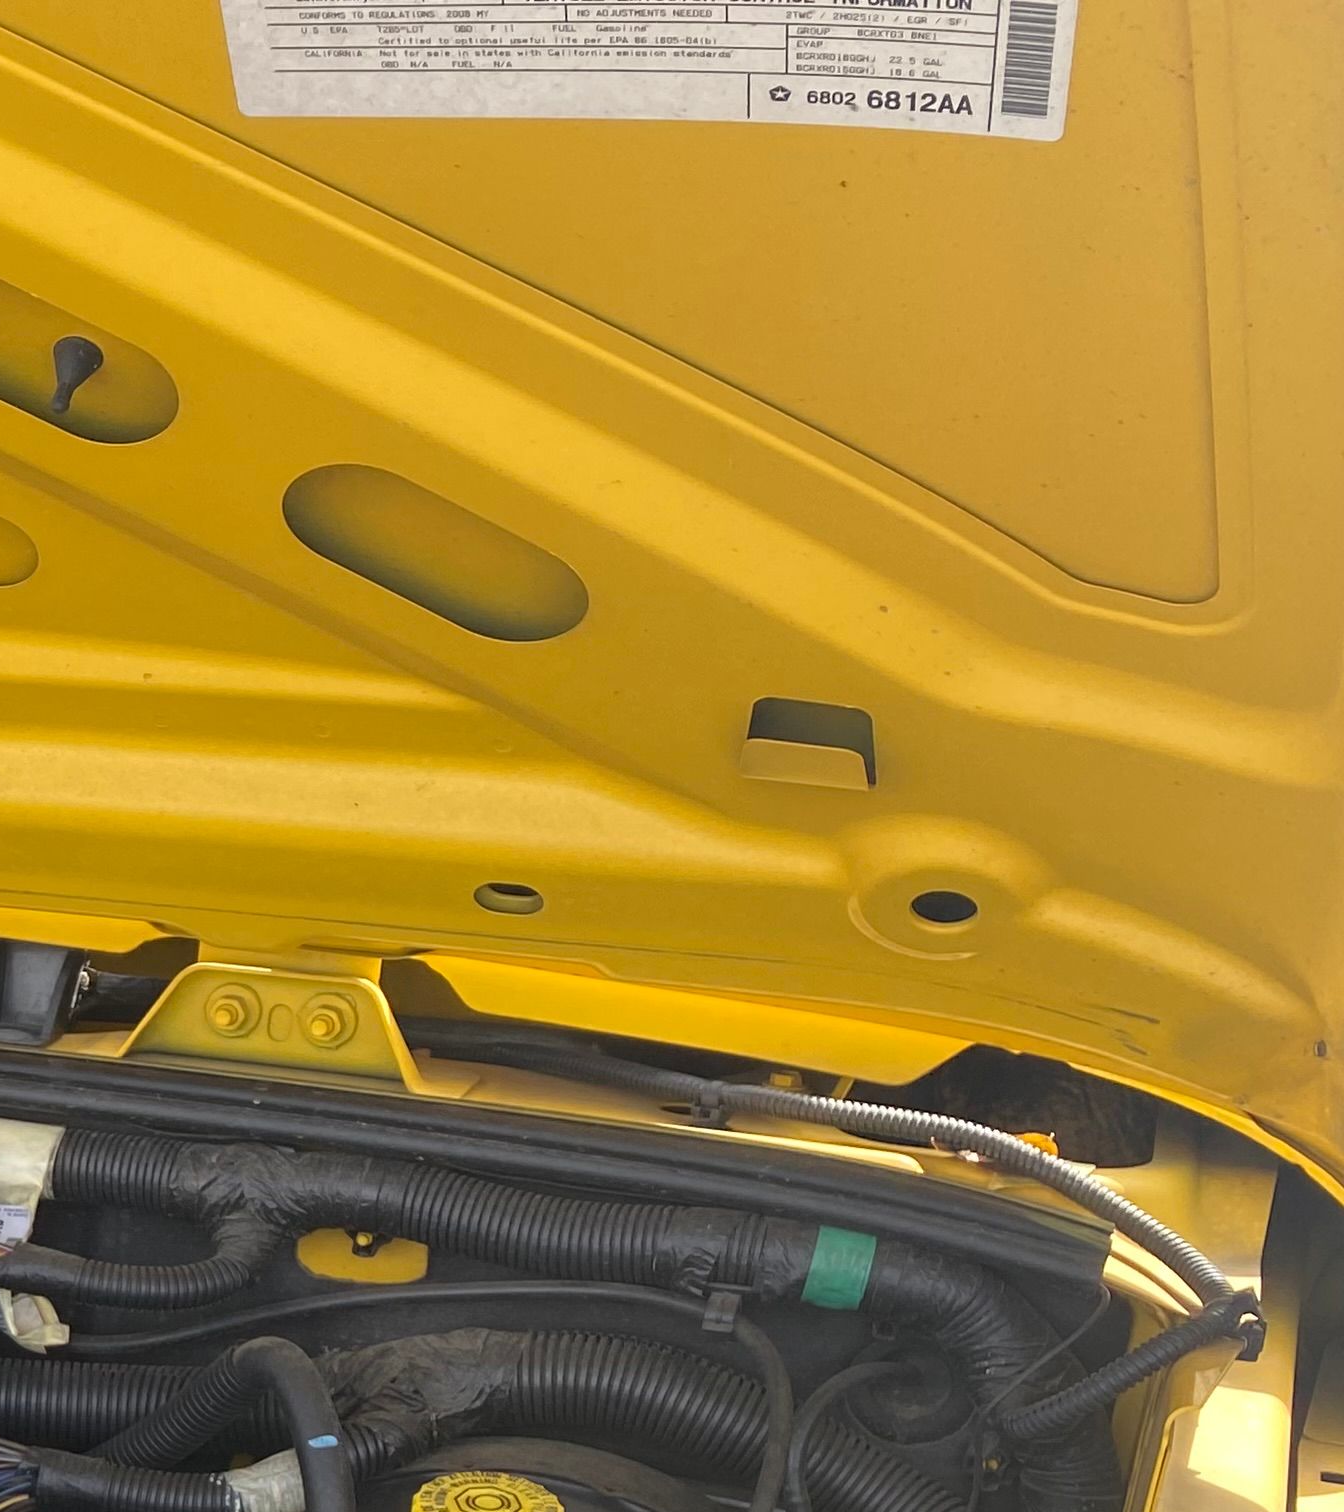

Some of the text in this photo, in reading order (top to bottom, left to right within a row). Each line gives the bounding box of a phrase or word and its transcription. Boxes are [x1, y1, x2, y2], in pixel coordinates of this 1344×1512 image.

[299, 12, 346, 20] CONFORMS
[368, 10, 435, 19] REGULATIONS
[446, 10, 471, 18] 2008
[476, 10, 489, 19] MY
[576, 9, 713, 17] NO ADJUSTMENTS NEEDED
[907, 16, 928, 24] EGR
[796, 27, 831, 35] GROUP
[378, 37, 432, 45] Certified
[455, 37, 503, 46] optional
[509, 36, 546, 44] useful
[554, 36, 578, 44] life
[584, 37, 602, 45] per
[609, 36, 629, 44] EPA
[404, 49, 420, 57] for
[427, 49, 450, 57] sale
[458, 49, 469, 57] in
[474, 49, 512, 57] states
[516, 49, 542, 57] with
[547, 49, 610, 57] California
[616, 49, 667, 57] emission
[410, 60, 429, 68] N/A
[493, 60, 512, 68] N/A
[923, 58, 943, 66] GAL
[922, 70, 943, 79] GAL
[806, 90, 974, 116] 6802 6812AA
